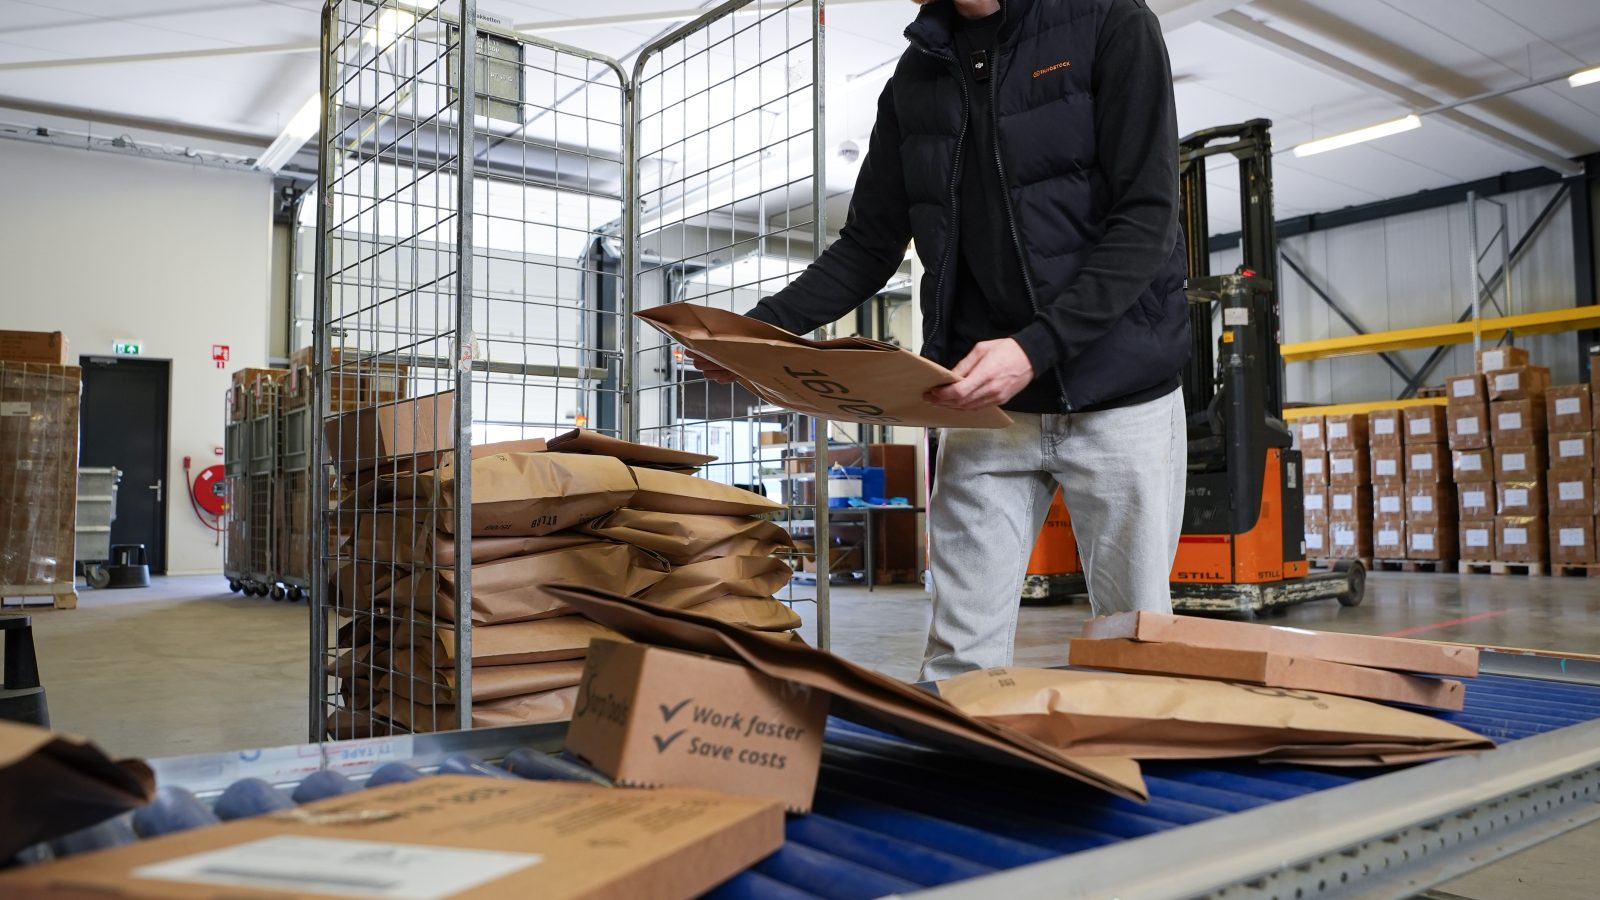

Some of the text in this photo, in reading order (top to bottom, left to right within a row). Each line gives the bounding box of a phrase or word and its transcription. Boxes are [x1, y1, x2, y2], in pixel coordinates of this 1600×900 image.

[1178, 571, 1225, 580] STILL
[1258, 570, 1281, 579] STILL
[692, 705, 806, 742] Work faster
[688, 736, 788, 770] Save costs
